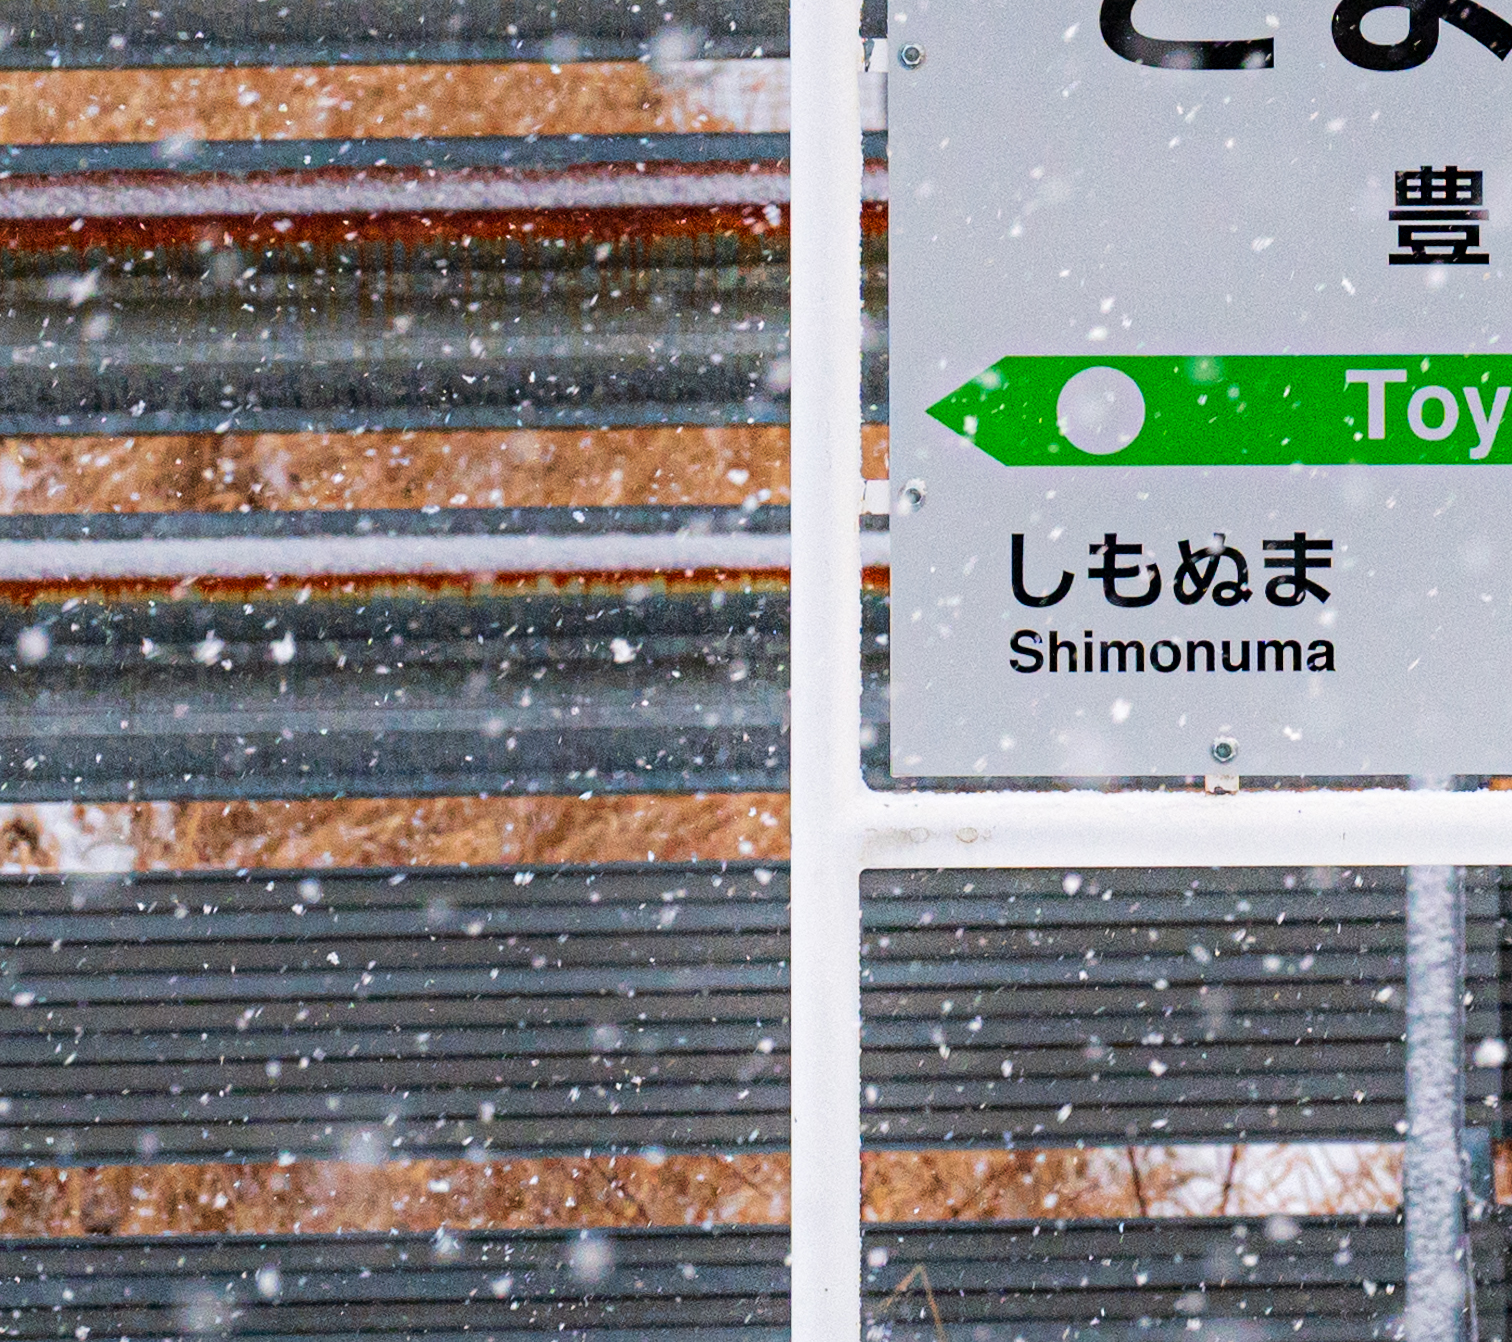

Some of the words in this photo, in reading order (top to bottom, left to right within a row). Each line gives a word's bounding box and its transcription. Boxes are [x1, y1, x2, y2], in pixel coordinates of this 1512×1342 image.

[1010, 531, 1334, 608] しもぬま
[1008, 629, 1336, 675] Shimonuma
